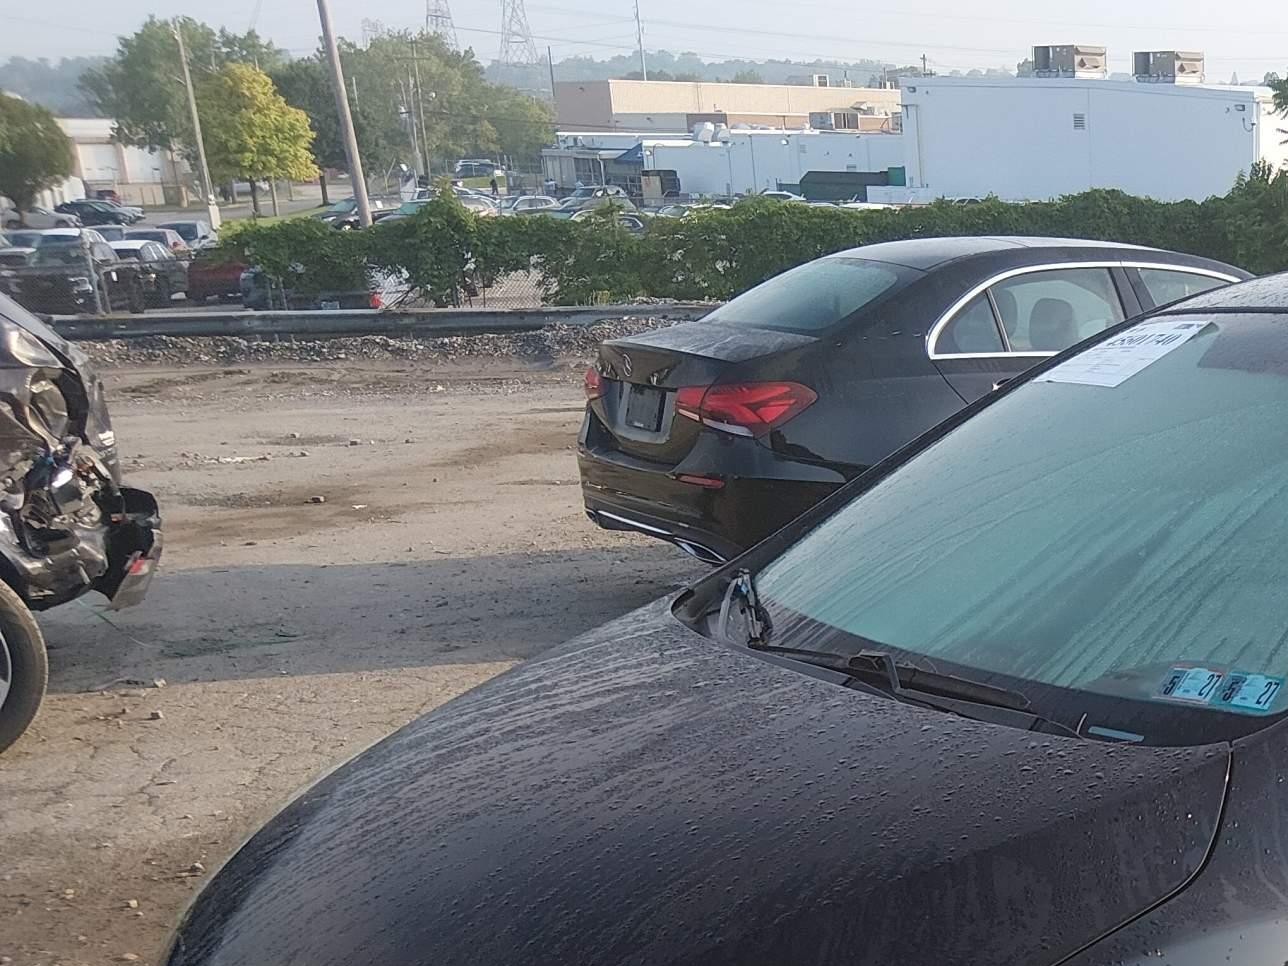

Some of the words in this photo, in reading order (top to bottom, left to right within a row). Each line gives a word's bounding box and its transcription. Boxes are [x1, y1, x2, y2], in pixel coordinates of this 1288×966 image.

[1163, 675, 1181, 696] 5
[1198, 673, 1222, 700] 27
[1222, 681, 1240, 702] 5
[1255, 681, 1280, 707] 27
